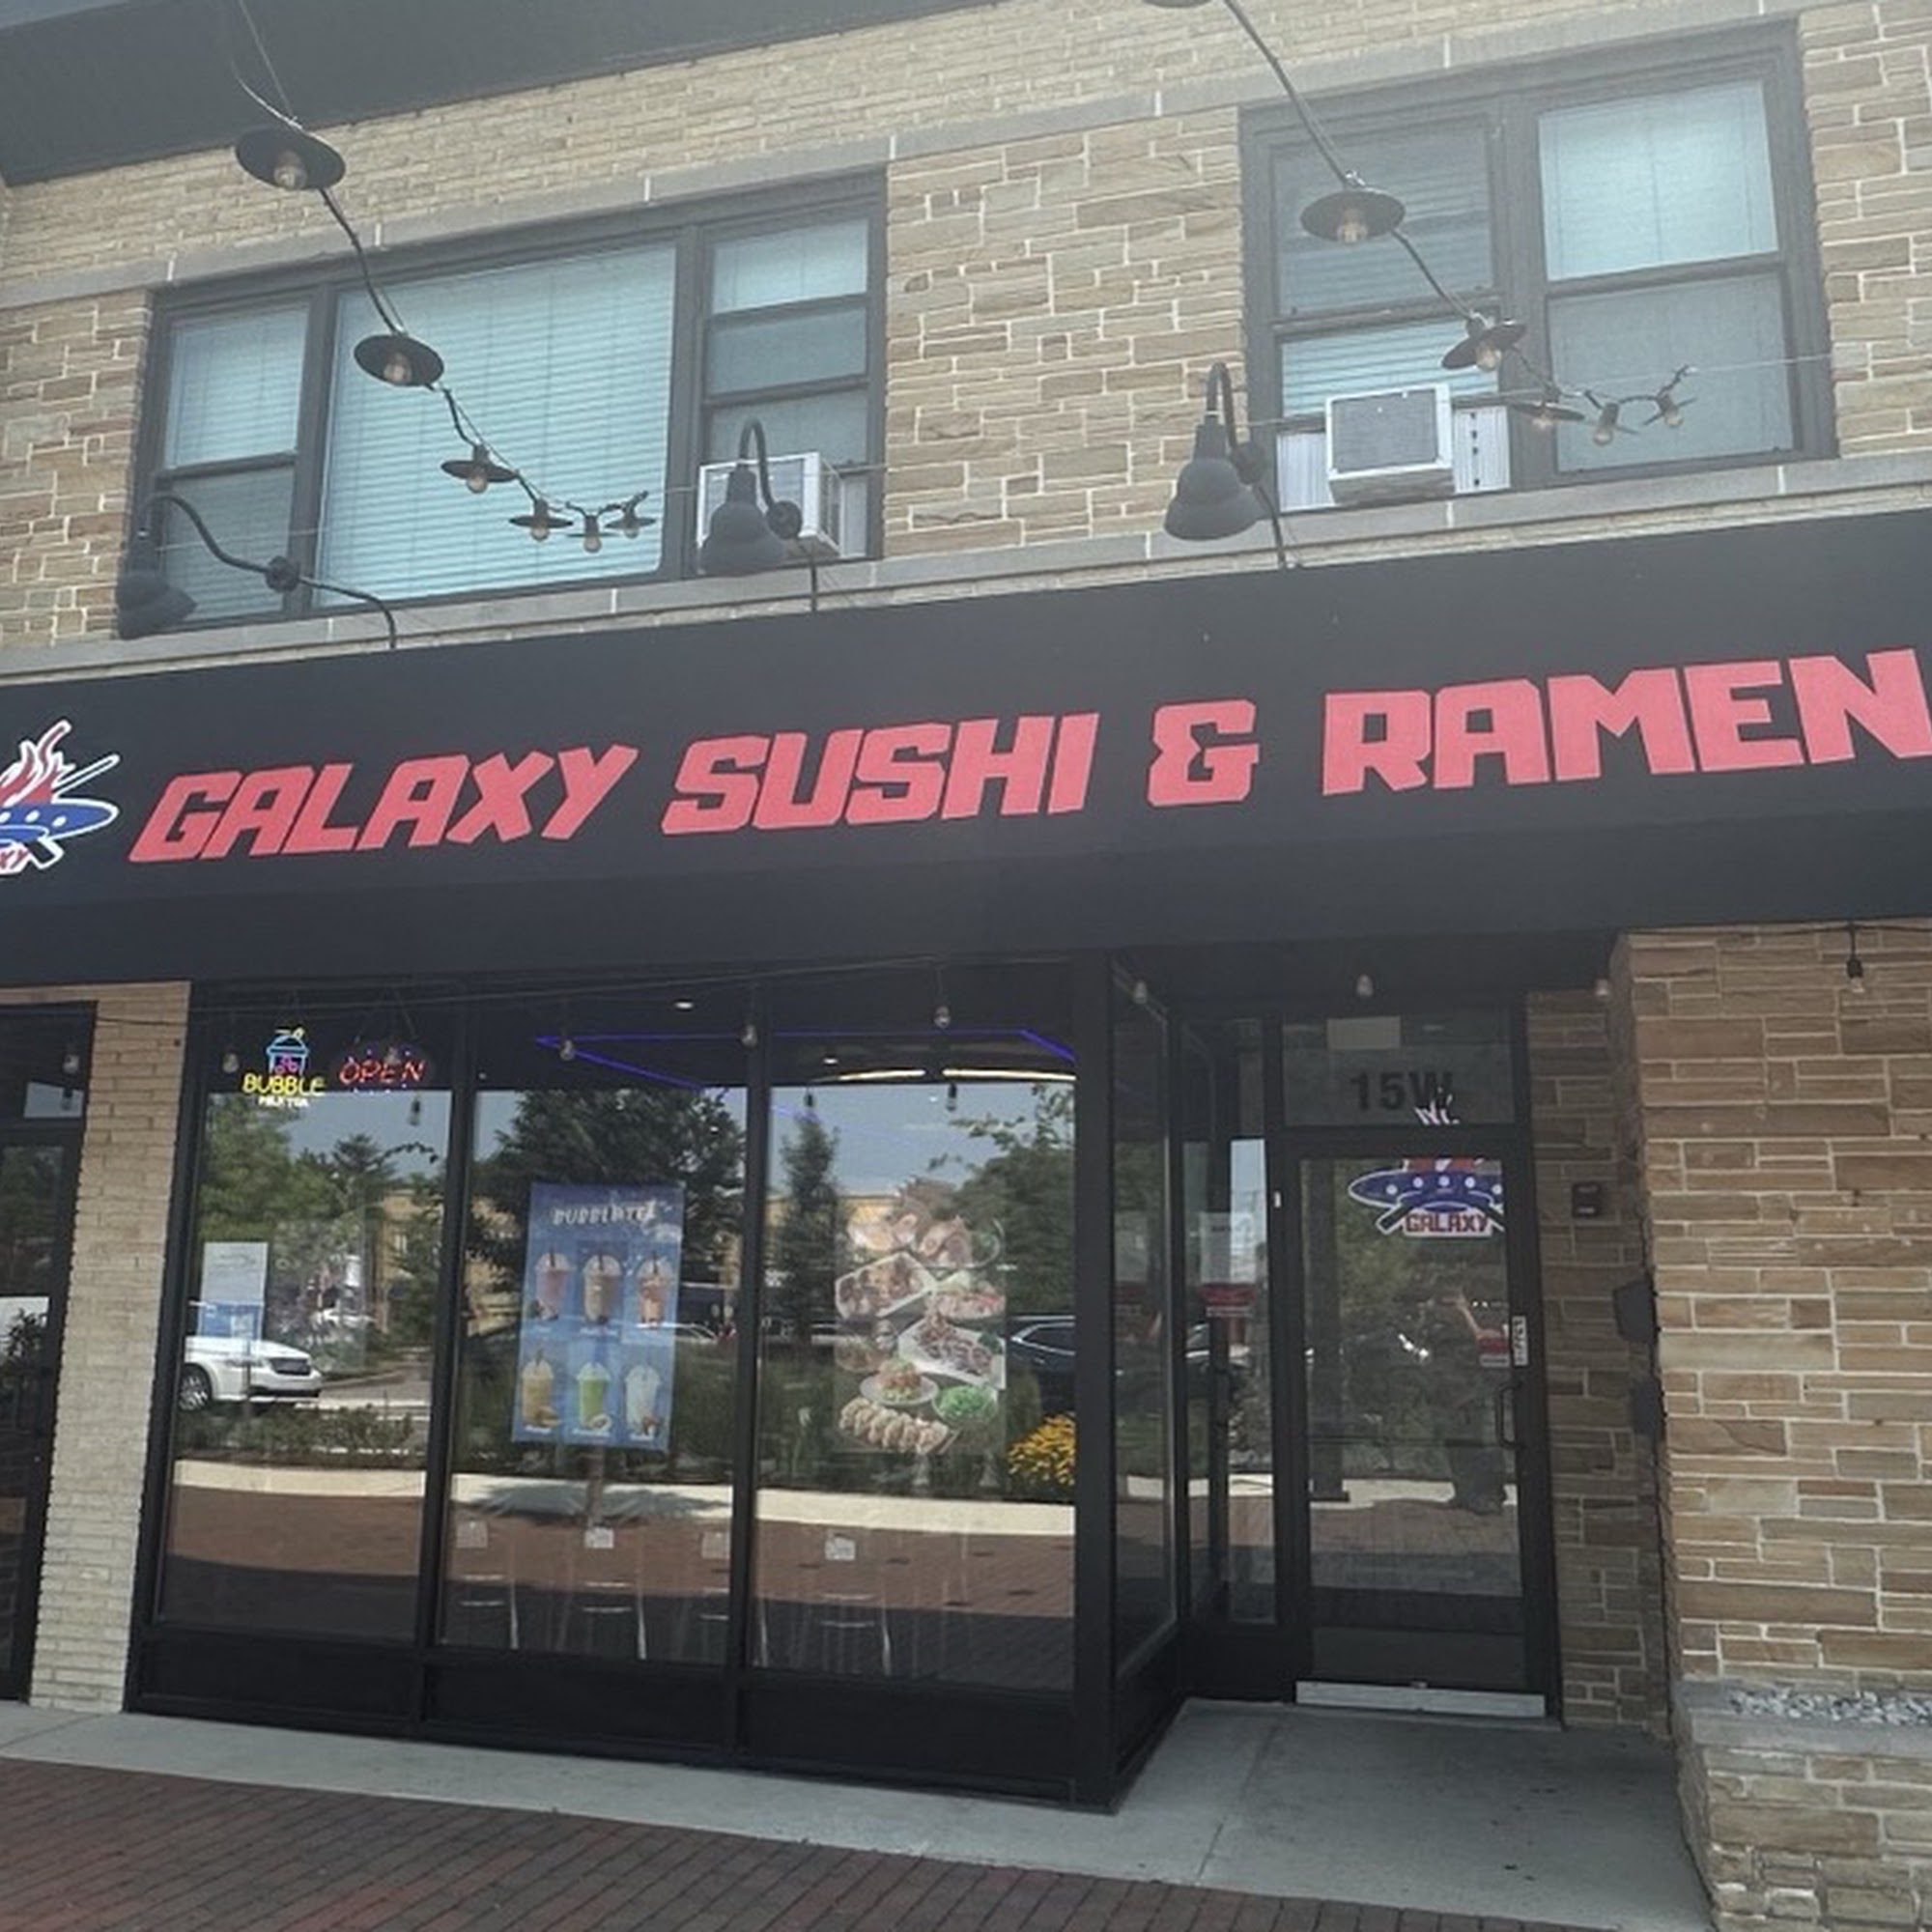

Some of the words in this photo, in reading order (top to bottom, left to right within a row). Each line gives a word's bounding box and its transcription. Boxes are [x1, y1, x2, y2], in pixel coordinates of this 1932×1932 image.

[129, 744, 639, 862] GALAXY
[661, 712, 1099, 835] SUSHI
[1147, 699, 1260, 808] &
[1322, 648, 1932, 796] RAMEN
[242, 1073, 326, 1096] BUBBLE
[339, 1059, 426, 1085] OPEN
[1350, 1071, 1454, 1112] 15W
[1406, 1214, 1489, 1233] GALAXY
